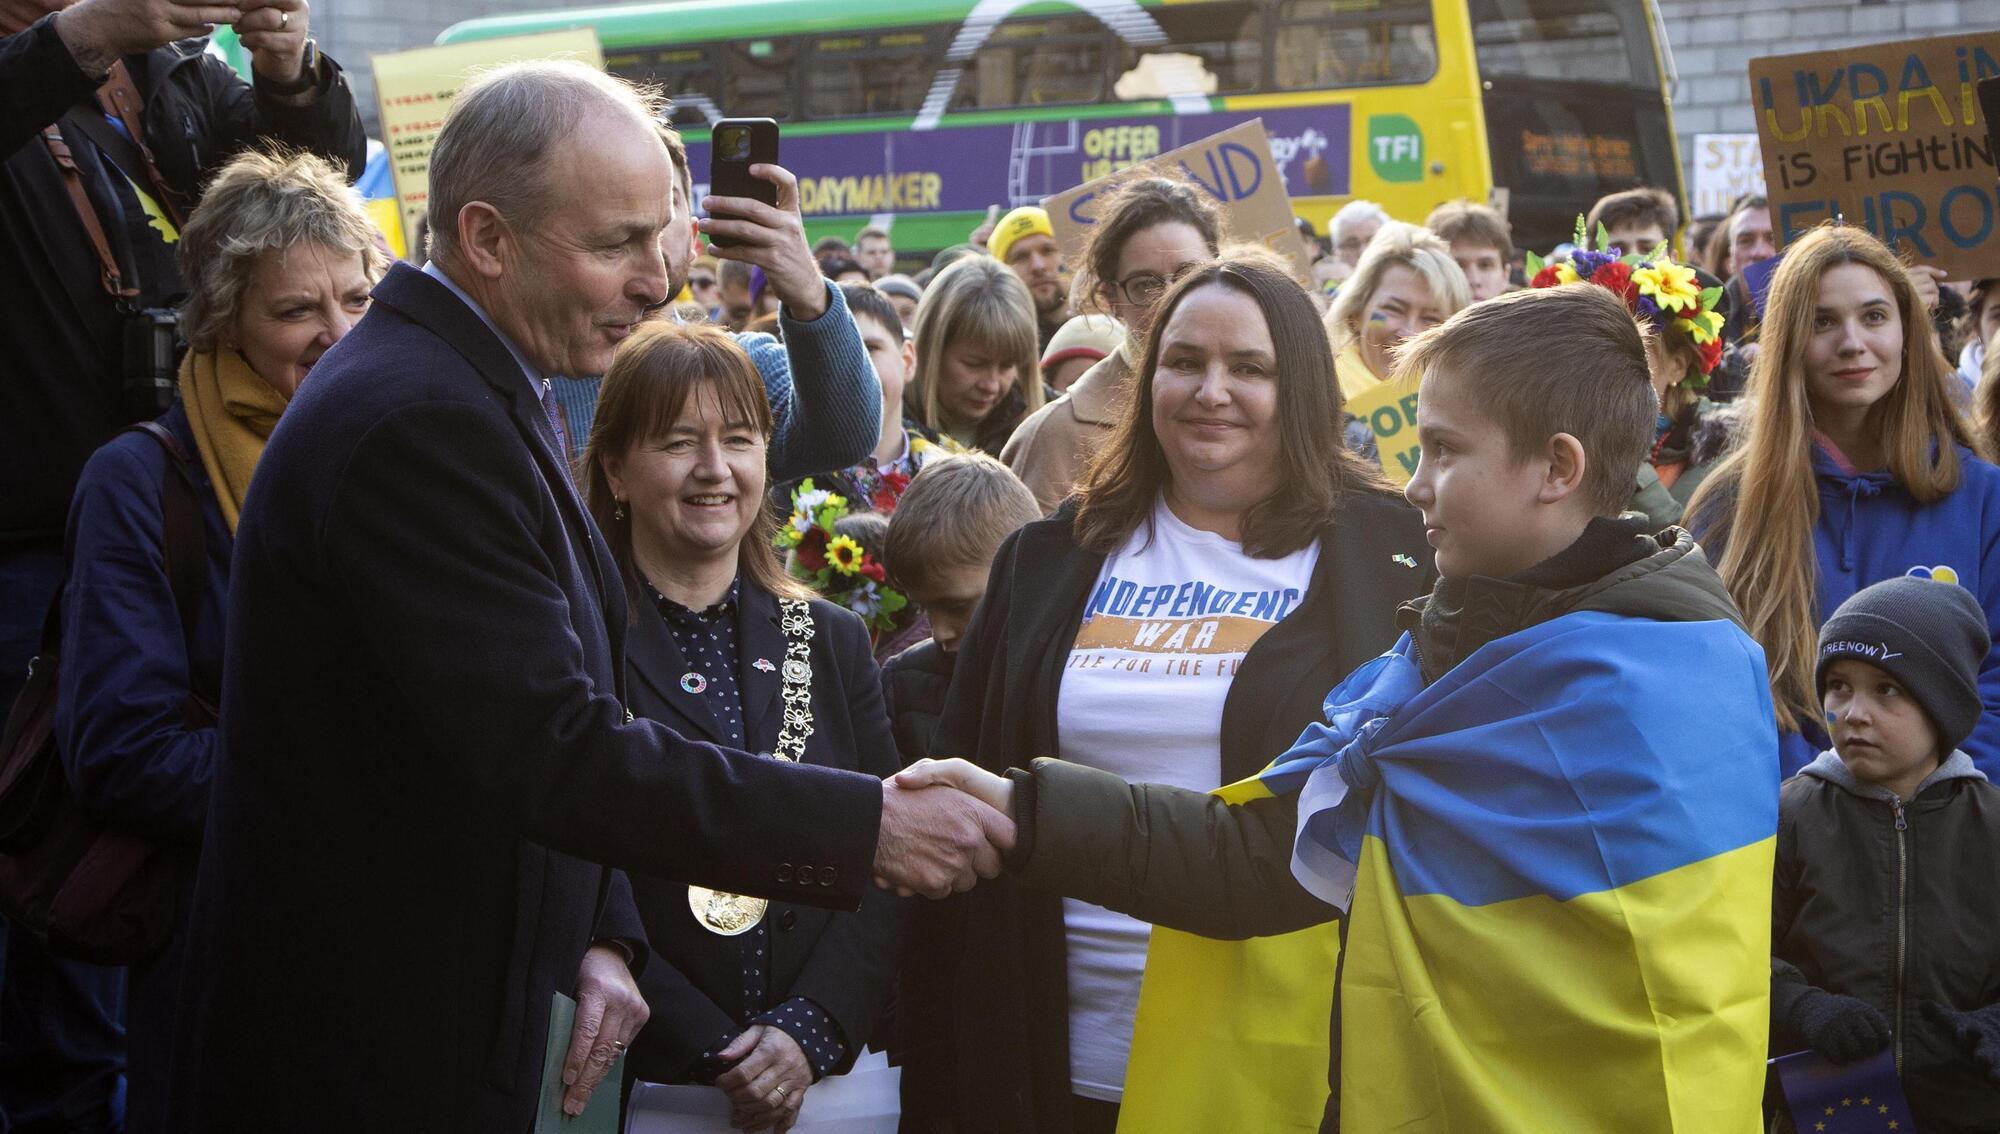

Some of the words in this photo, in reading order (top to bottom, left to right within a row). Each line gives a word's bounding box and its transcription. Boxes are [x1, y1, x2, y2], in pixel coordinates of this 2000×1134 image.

[1083, 125, 1159, 158] OFFER
[1373, 135, 1419, 162] TFI
[799, 171, 942, 213] DAYMAKER
[1084, 576, 1301, 621] NDEPENDENC
[1132, 620, 1219, 649] WAR
[1112, 657, 1152, 673] FOR
[1165, 659, 1203, 676] THE
